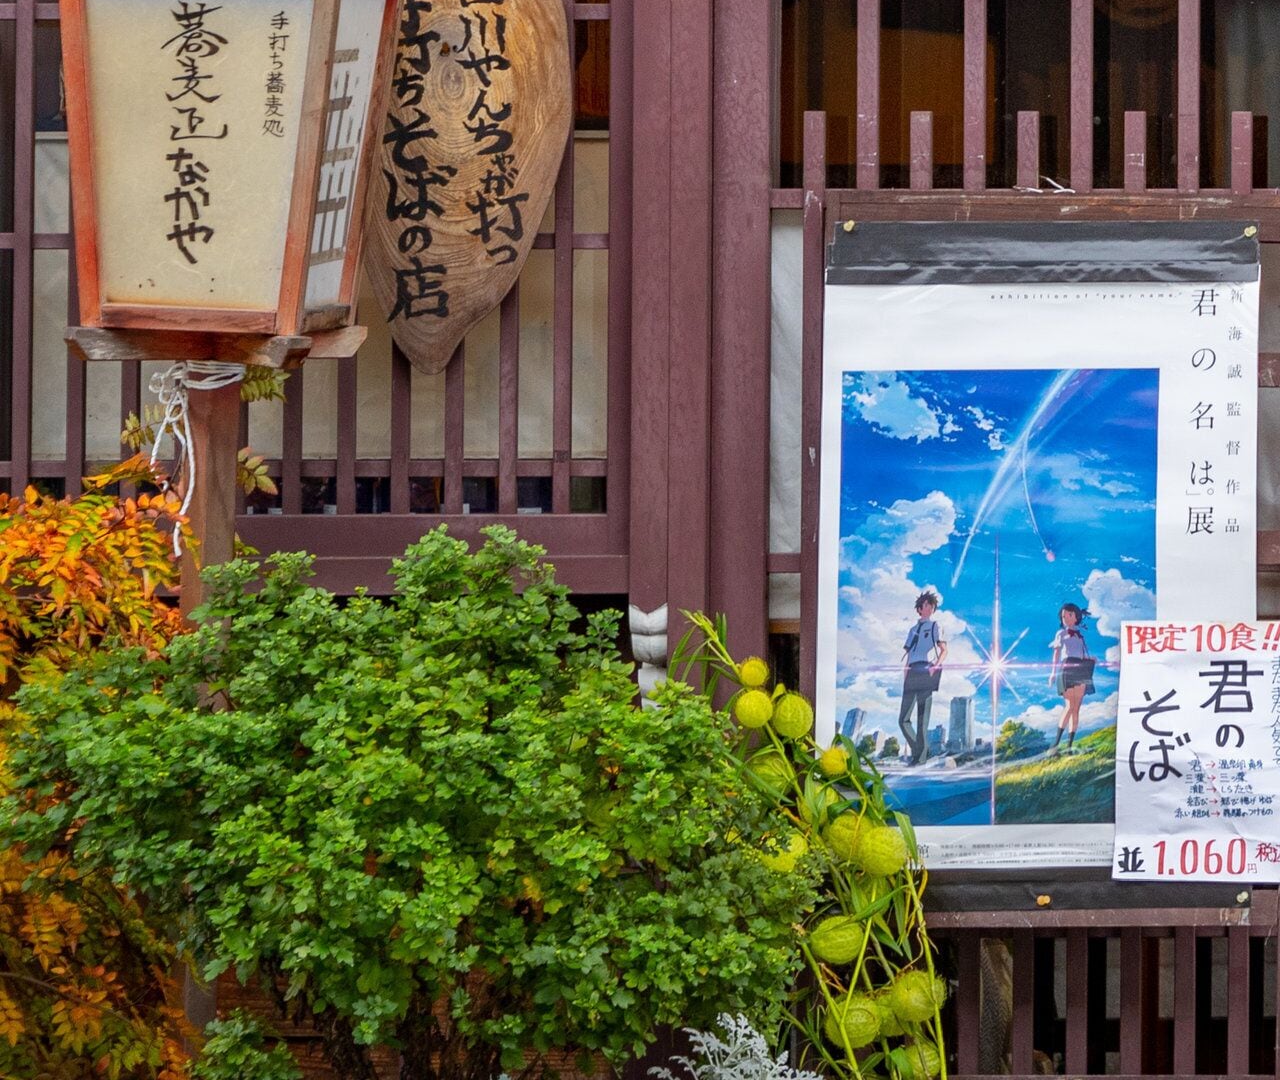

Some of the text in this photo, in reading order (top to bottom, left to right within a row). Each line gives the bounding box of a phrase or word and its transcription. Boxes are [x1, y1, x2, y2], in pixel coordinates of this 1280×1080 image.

[262, 10, 290, 138] 手打ち蕎麦処
[1225, 287, 1243, 534] 新海誠監督作品
[1129, 688, 1192, 783] そば
[1199, 659, 1264, 749] 君の
[1117, 846, 1146, 874] 並
